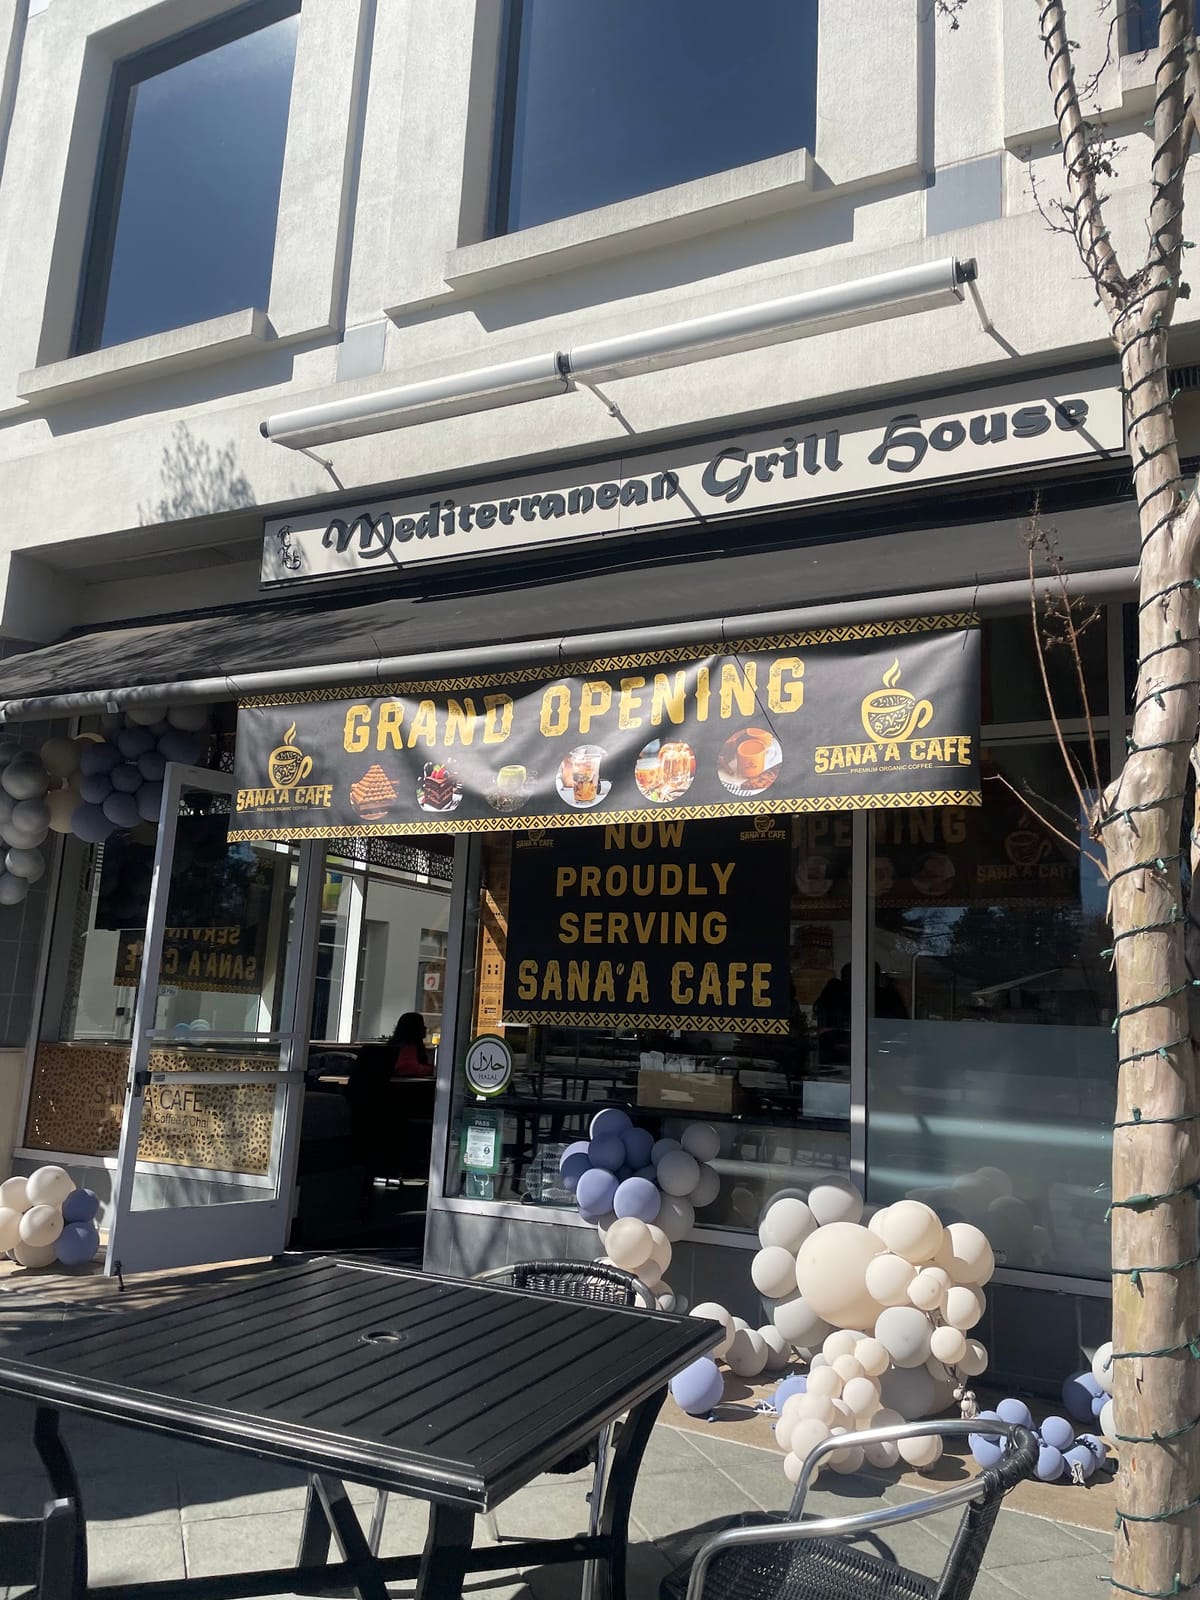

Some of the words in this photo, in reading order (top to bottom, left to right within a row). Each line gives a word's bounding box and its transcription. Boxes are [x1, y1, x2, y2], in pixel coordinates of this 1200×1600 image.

[321, 471, 679, 559] Mediterranean
[702, 430, 843, 503] Grill
[868, 398, 1089, 473] House
[343, 693, 514, 753] GRAND
[540, 656, 806, 737] OPENING
[814, 743, 900, 774] SANA'A
[910, 737, 972, 765] CAFE
[236, 788, 289, 812] SANA'A
[295, 785, 333, 807] CAFE
[604, 820, 685, 850] NOW
[768, 830, 786, 840] CAFE
[556, 862, 736, 897] PROUDLY
[558, 911, 727, 945] SERVING
[517, 959, 650, 1004] SANA'A
[670, 961, 772, 1008] CAFE
[472, 1051, 505, 1072] حلال
[478, 1073, 498, 1081] HALAL
[160, 1089, 204, 1113] CAFE
[153, 1112, 181, 1125] Coffee
